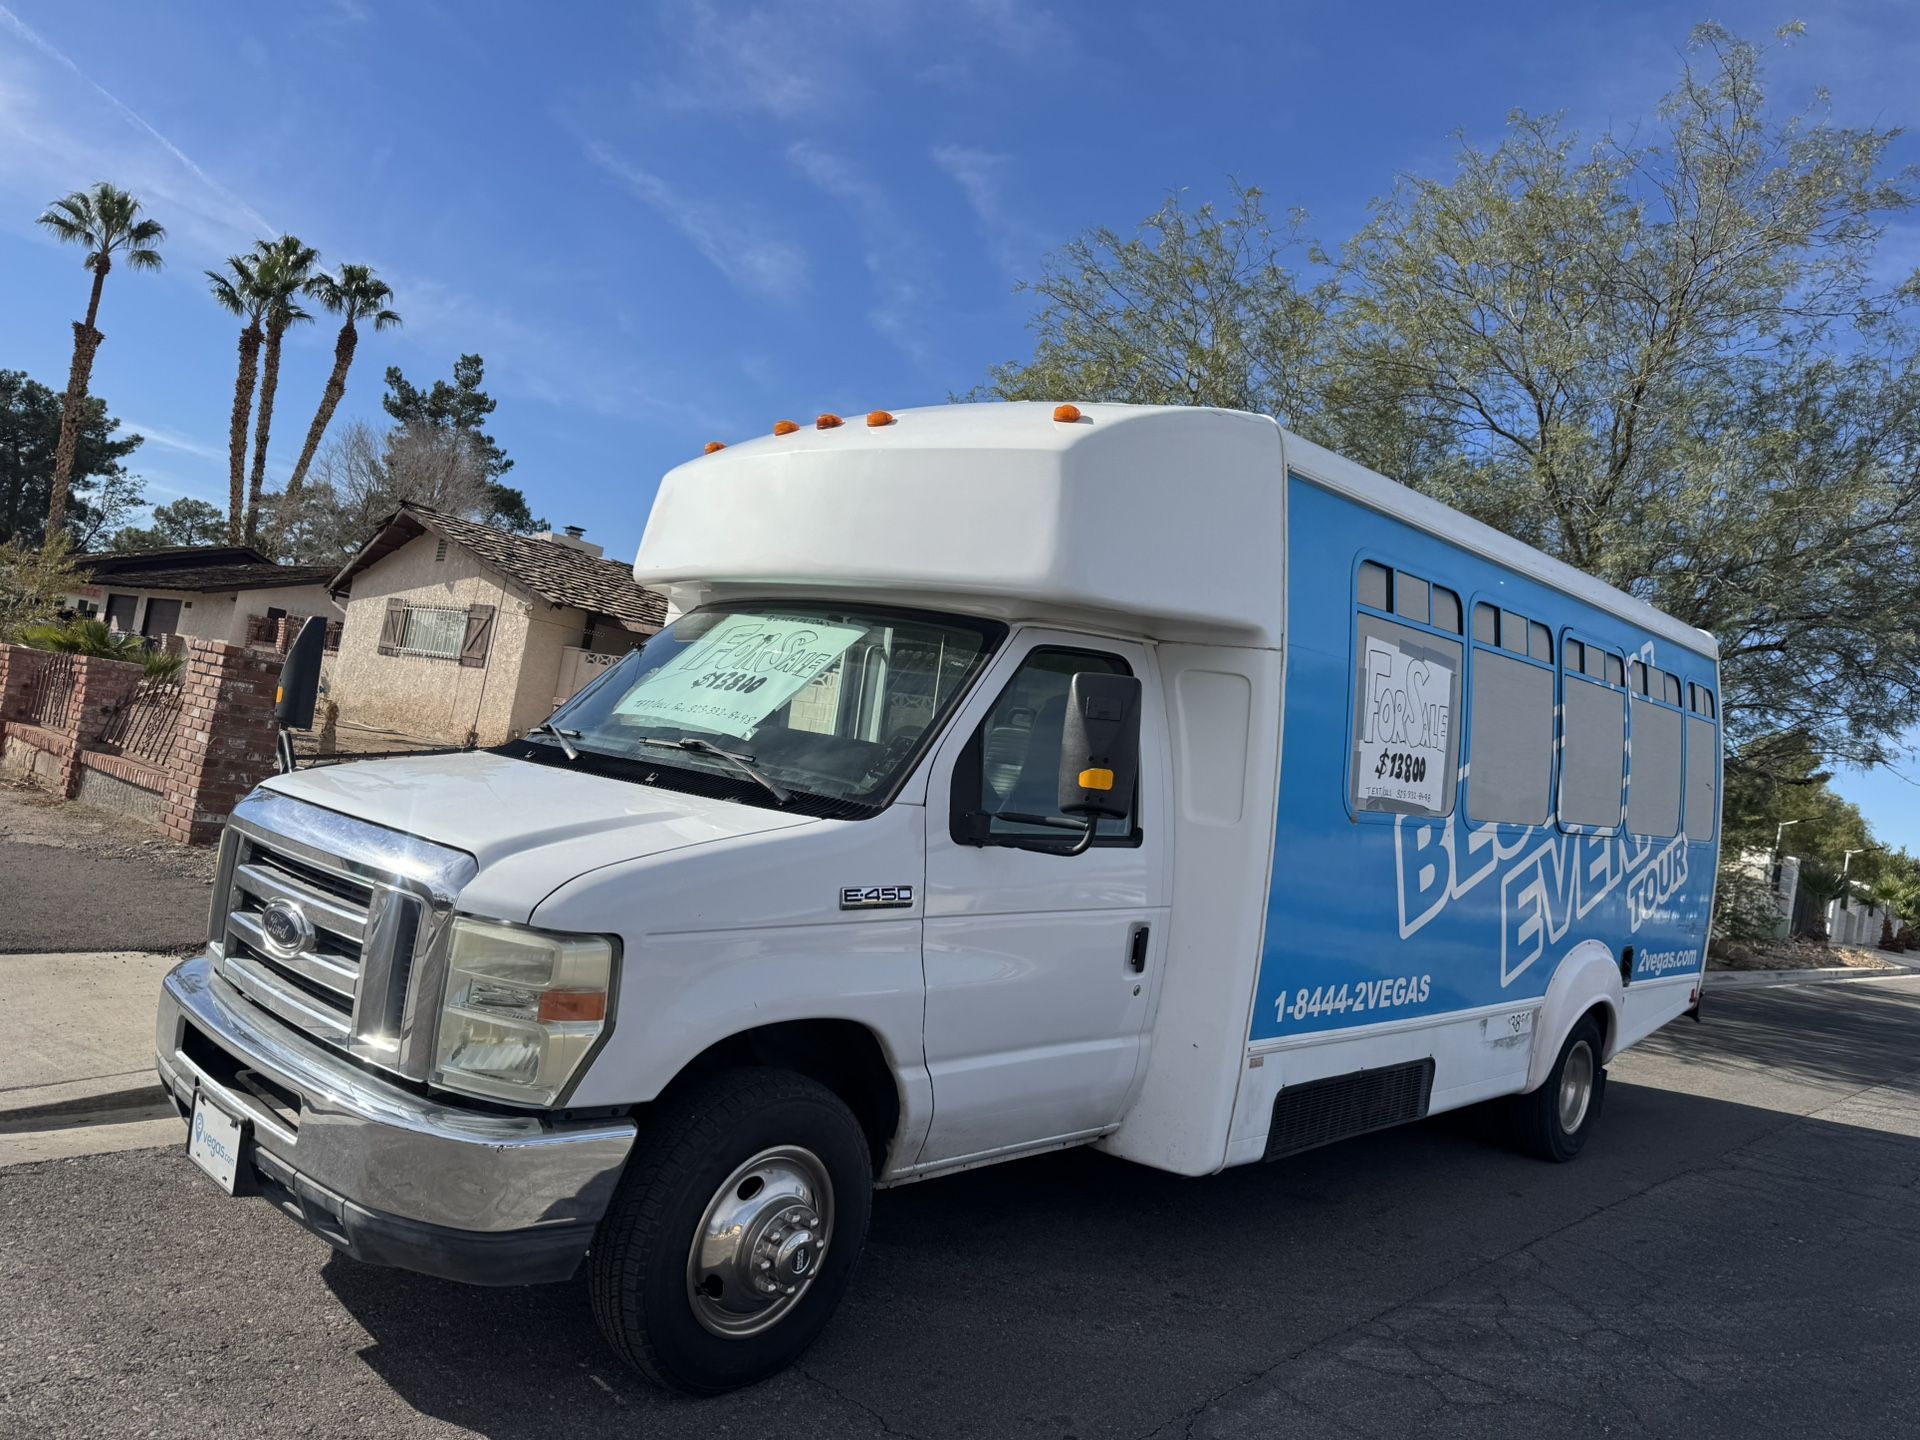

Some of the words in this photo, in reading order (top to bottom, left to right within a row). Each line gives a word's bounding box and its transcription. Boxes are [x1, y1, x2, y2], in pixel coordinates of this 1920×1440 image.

[754, 629, 832, 679] SALE
[1363, 649, 1406, 744] FOR
[1405, 658, 1450, 753] SALE
[1626, 831, 1689, 933] TOUR
[1637, 947, 1697, 976] 2vegas.com
[1274, 973, 1432, 1023] 1-8444-2VEGAS
